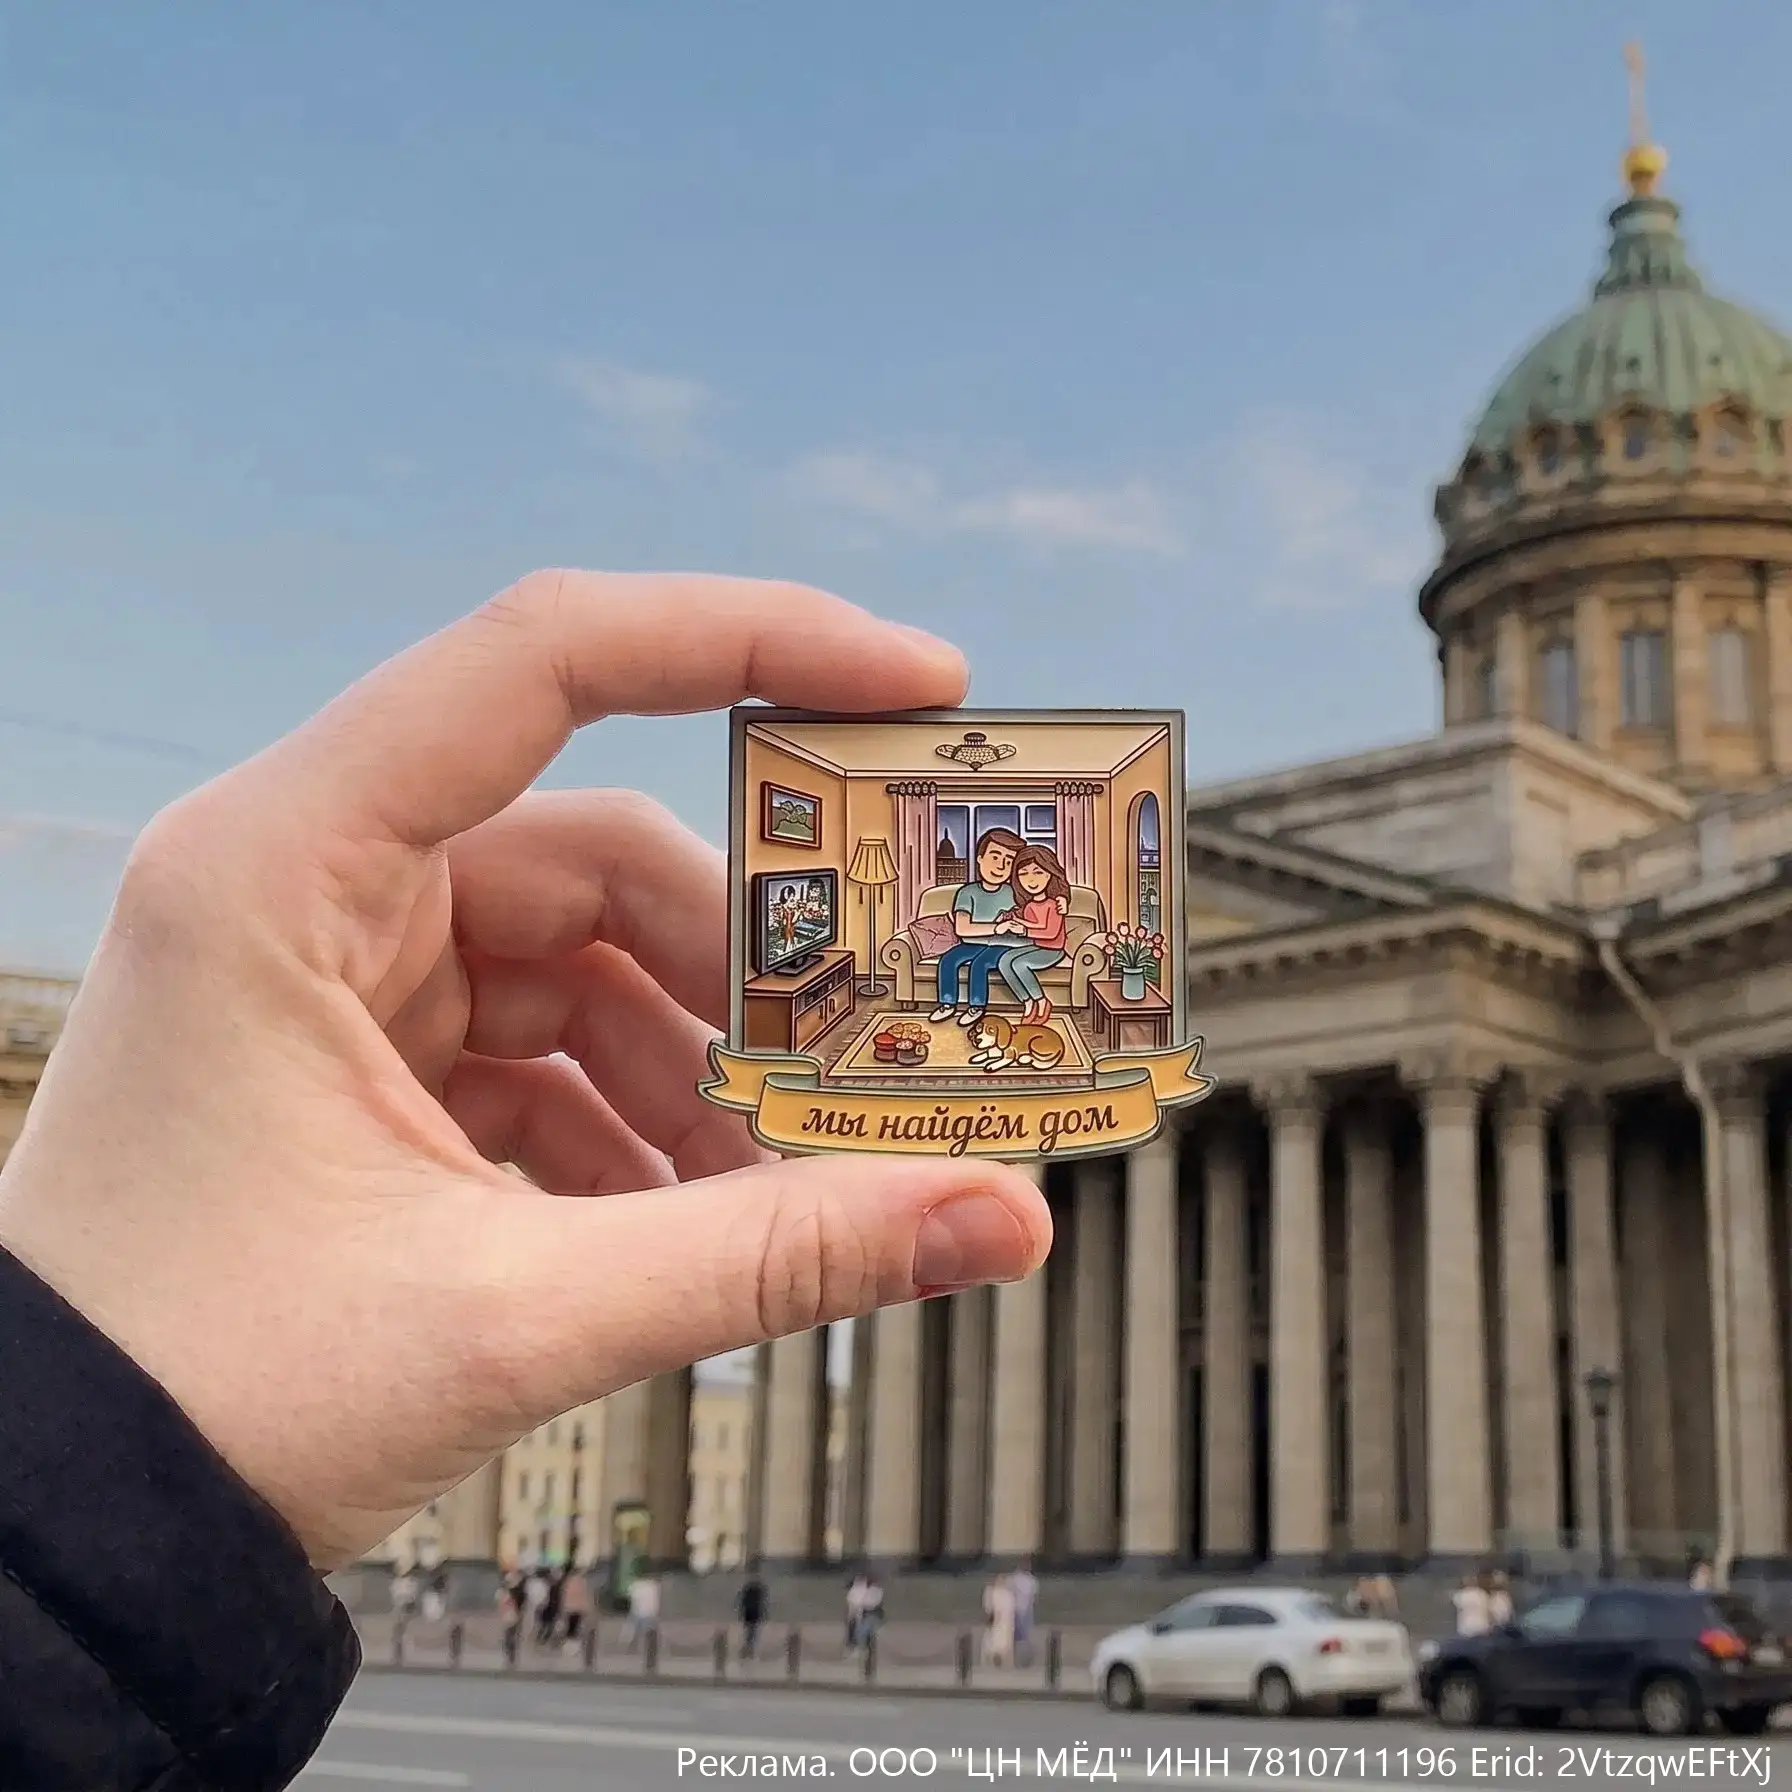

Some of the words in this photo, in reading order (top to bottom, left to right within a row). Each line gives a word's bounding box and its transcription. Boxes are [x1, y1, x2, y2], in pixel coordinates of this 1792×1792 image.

[801, 1105, 868, 1138] мы
[878, 1105, 1029, 1157] найдём
[1039, 1103, 1119, 1153] дом
